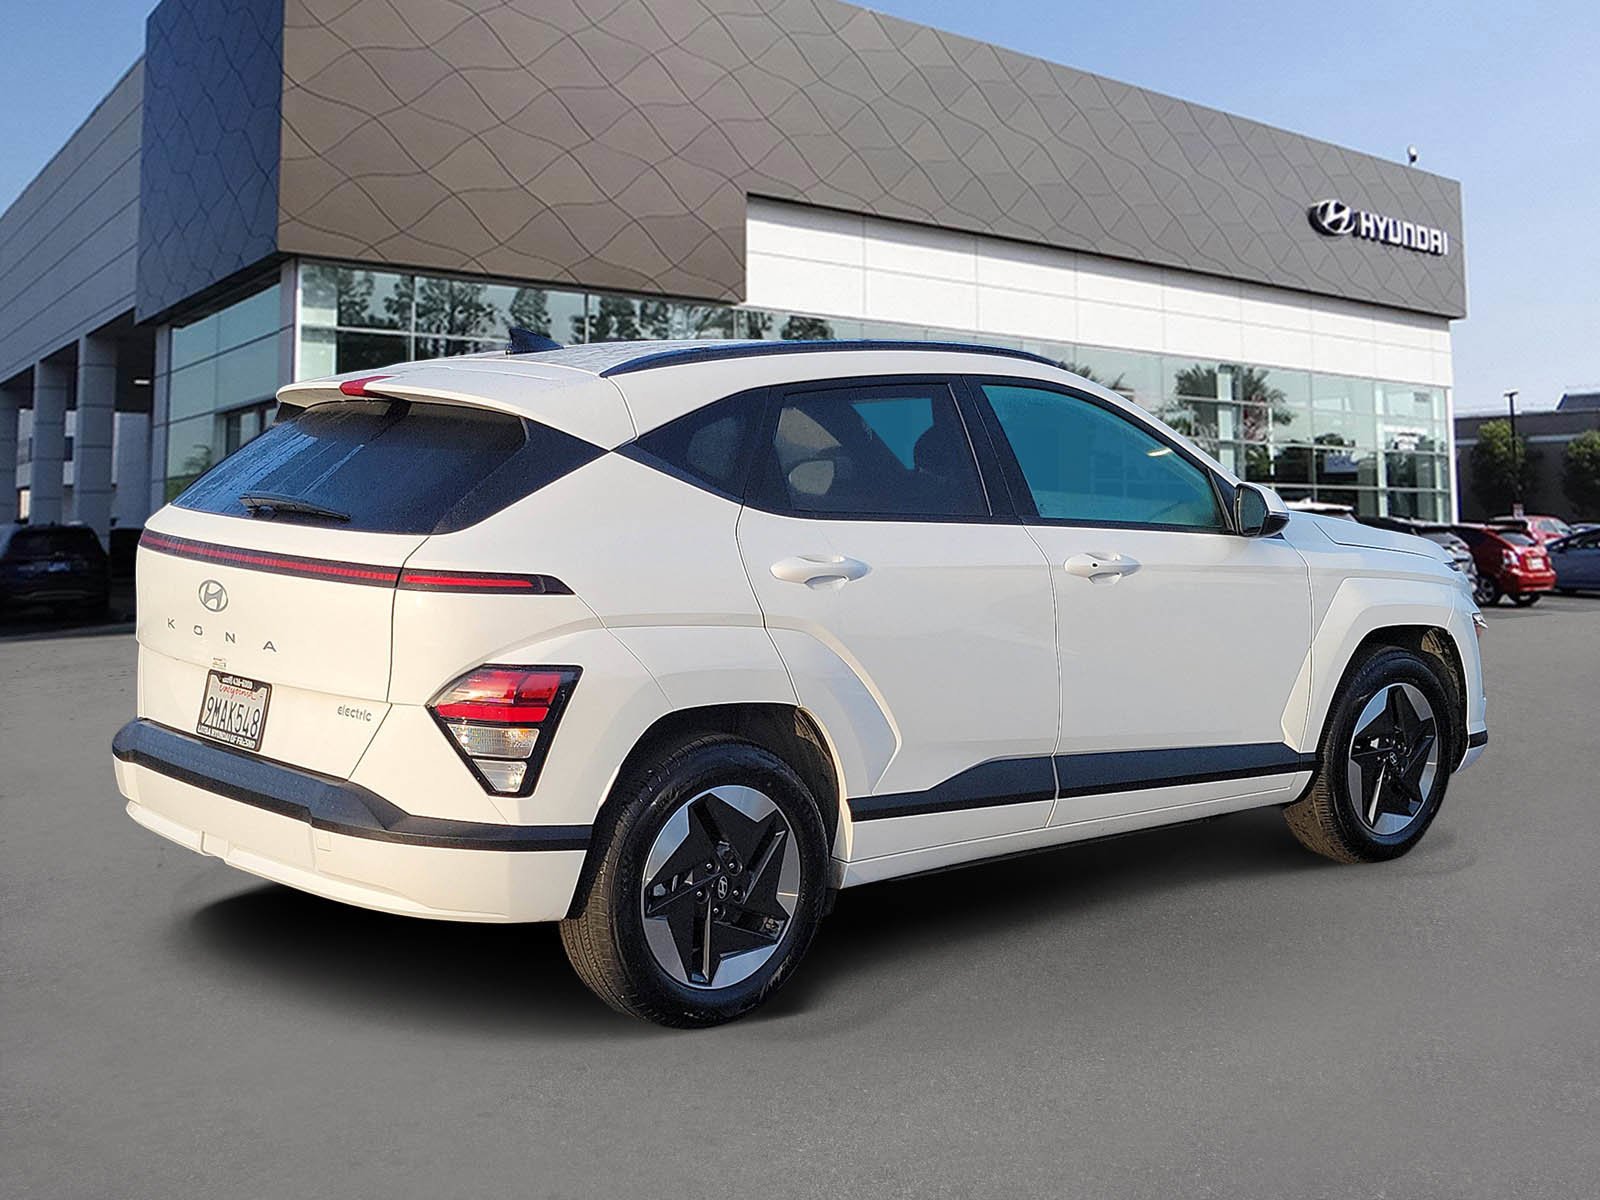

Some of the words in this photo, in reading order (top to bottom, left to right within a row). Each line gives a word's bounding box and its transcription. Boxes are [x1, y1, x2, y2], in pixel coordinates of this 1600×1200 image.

[1360, 211, 1449, 255] HYUNDAI
[167, 618, 277, 652] KONA
[203, 696, 261, 738] 9MAK548
[337, 703, 372, 722] electric
